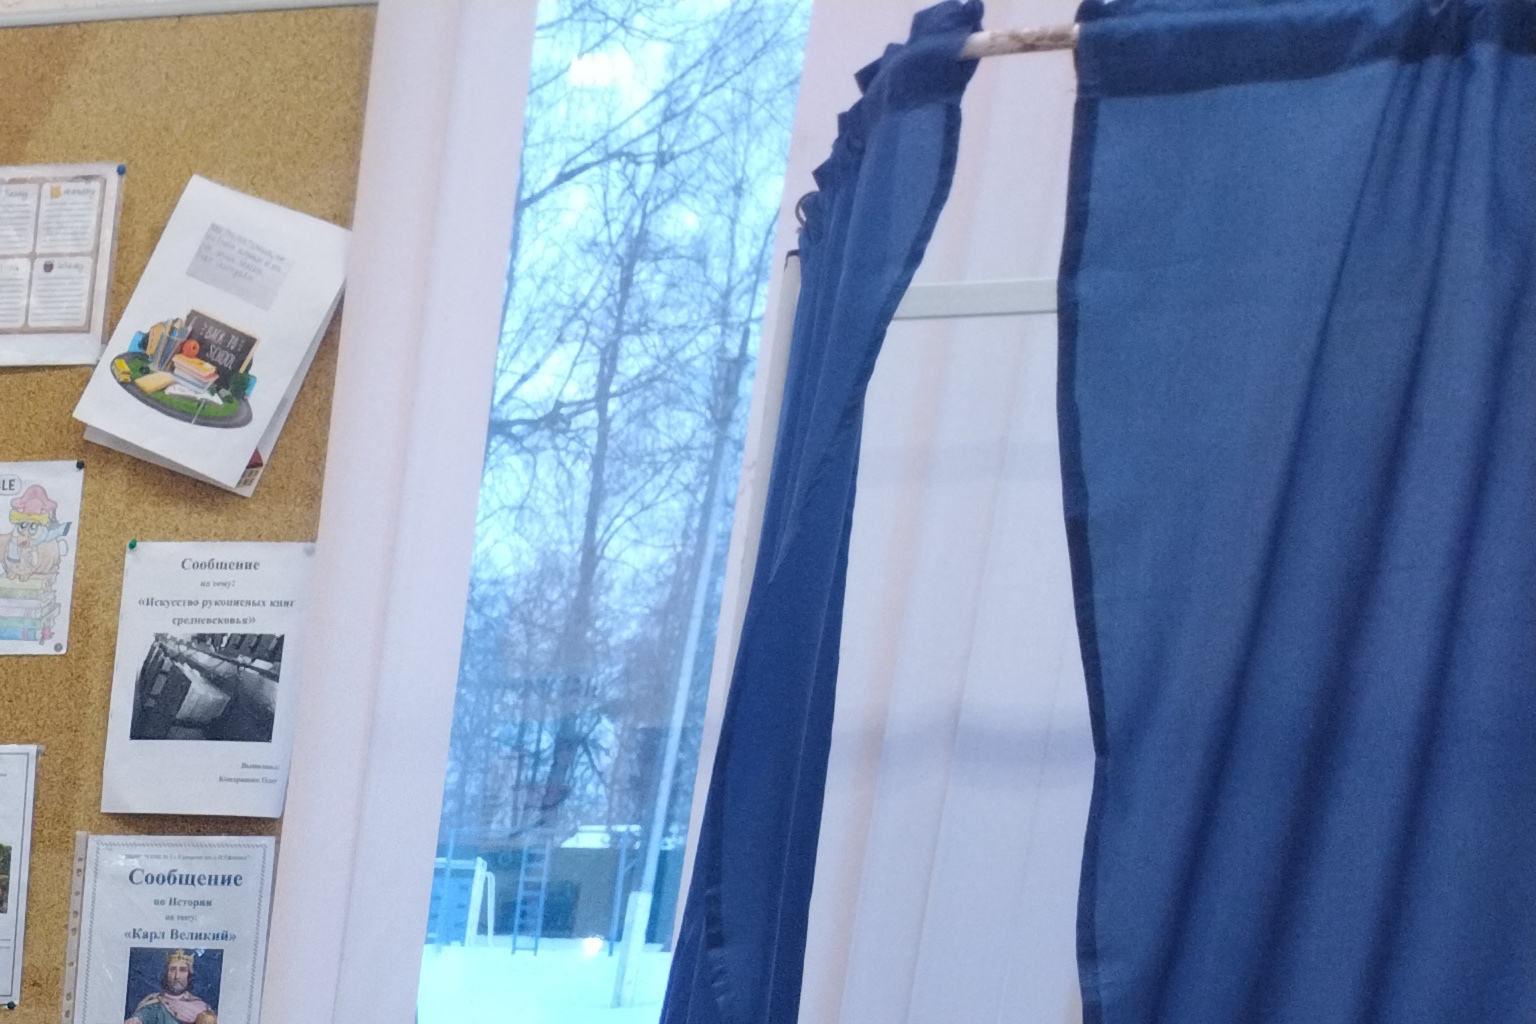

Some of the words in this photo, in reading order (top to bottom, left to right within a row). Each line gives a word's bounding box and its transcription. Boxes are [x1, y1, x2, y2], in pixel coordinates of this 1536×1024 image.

[181, 557, 260, 572] Сообщение
[128, 868, 243, 887] Сообщение
[168, 897, 212, 908] Истории
[124, 929, 166, 941] «Карл
[170, 928, 237, 943] Великий»
